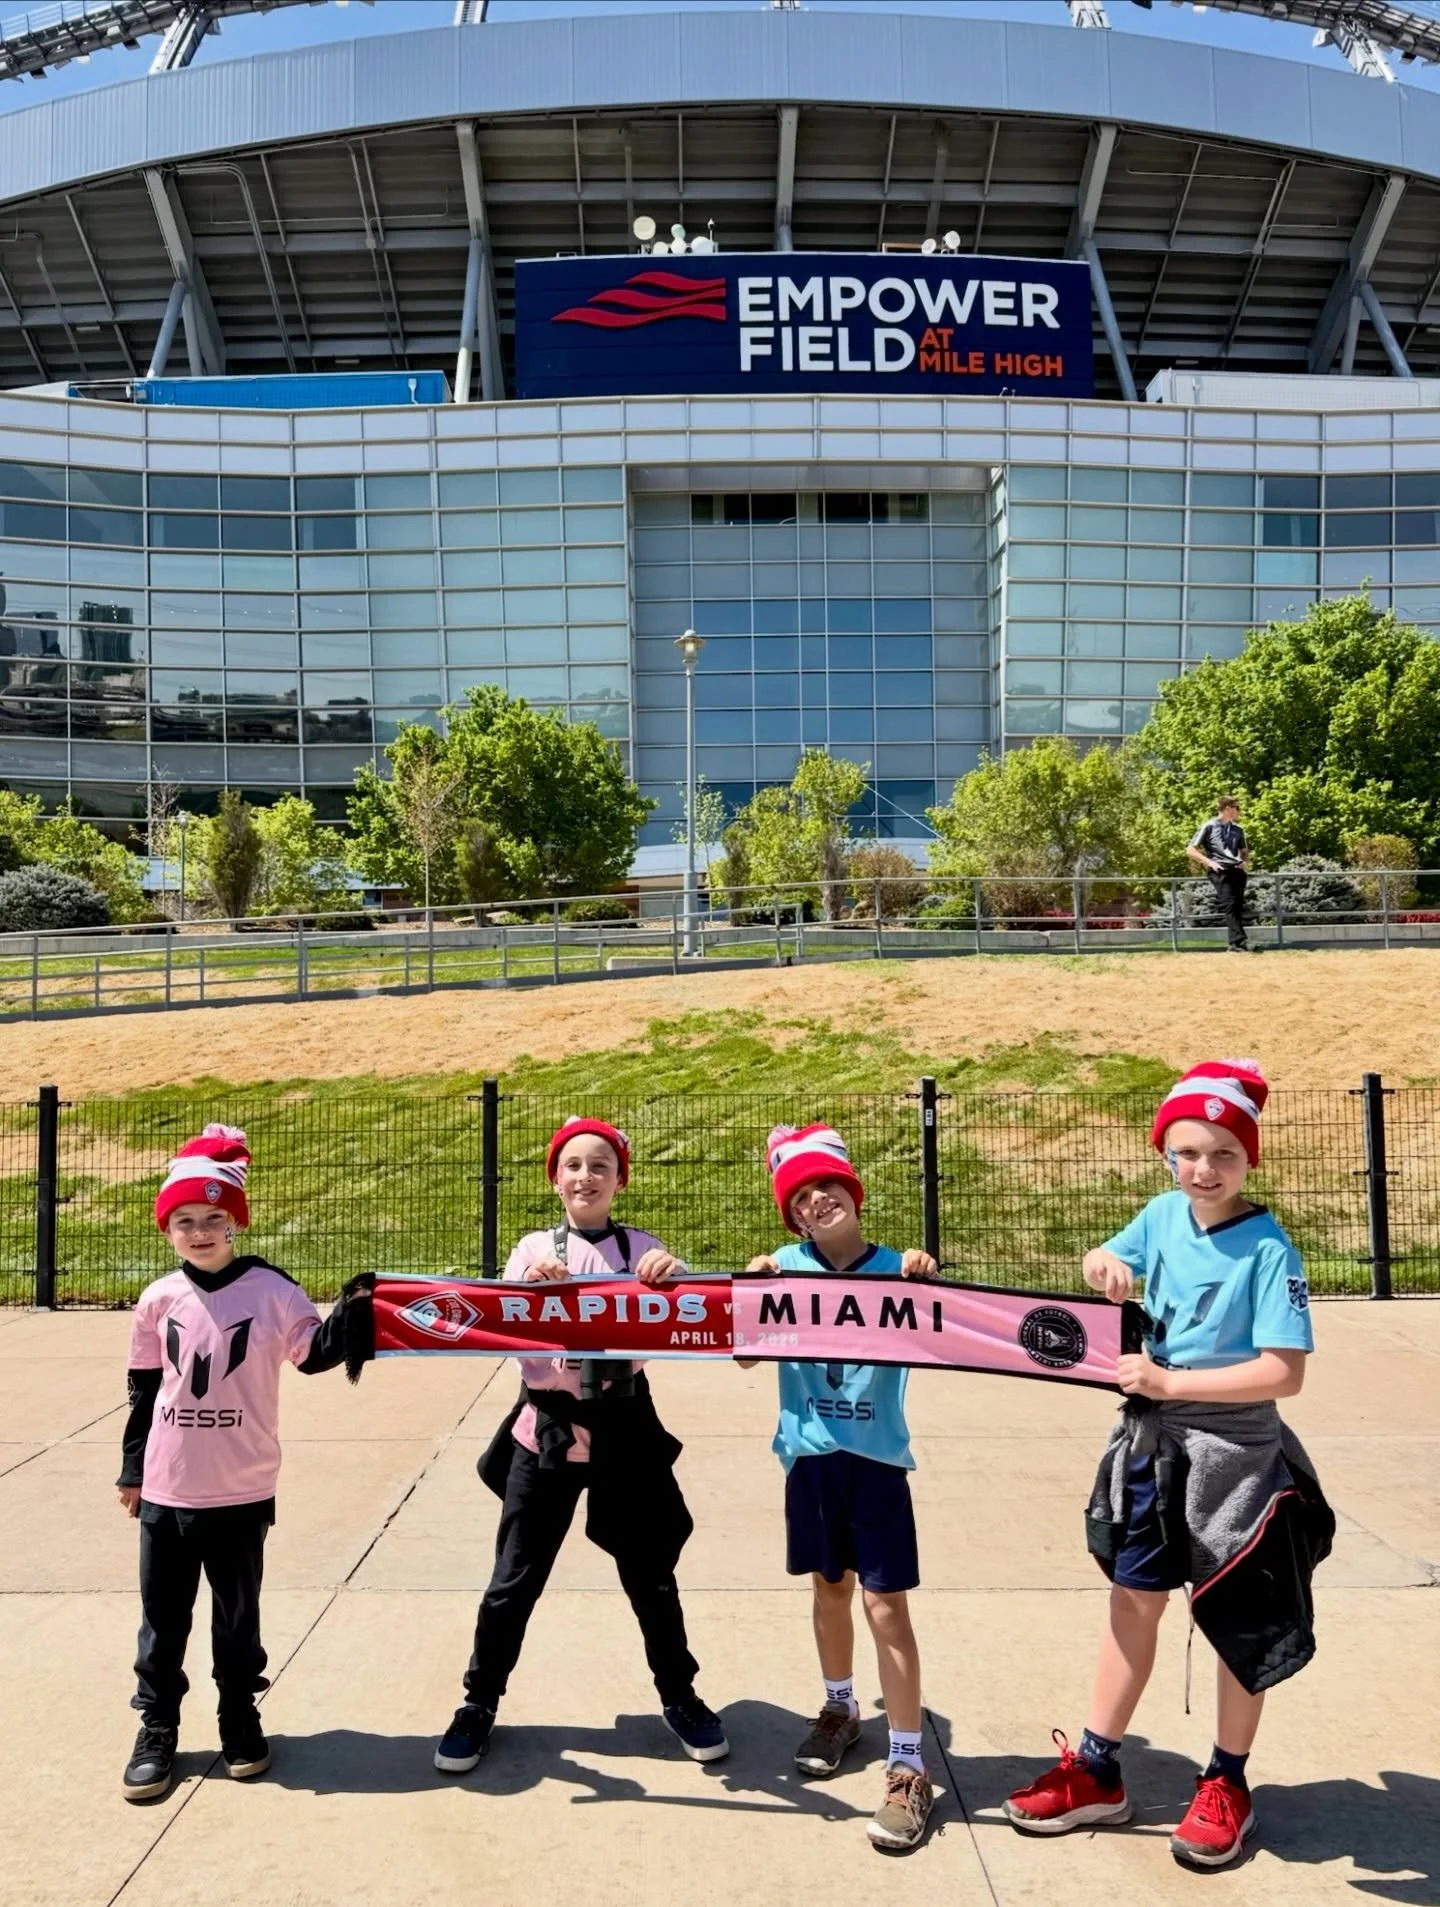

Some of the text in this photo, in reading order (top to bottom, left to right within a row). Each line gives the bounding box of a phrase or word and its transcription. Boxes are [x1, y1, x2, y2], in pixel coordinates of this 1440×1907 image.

[737, 275, 1061, 329] EMPOWER
[740, 326, 915, 373] FIELD
[919, 327, 954, 350] AT
[918, 351, 1063, 377] MILE HIGH
[499, 1293, 707, 1323] RAPIDS
[758, 1293, 944, 1333] MIAMI
[669, 1331, 718, 1345] APRIL
